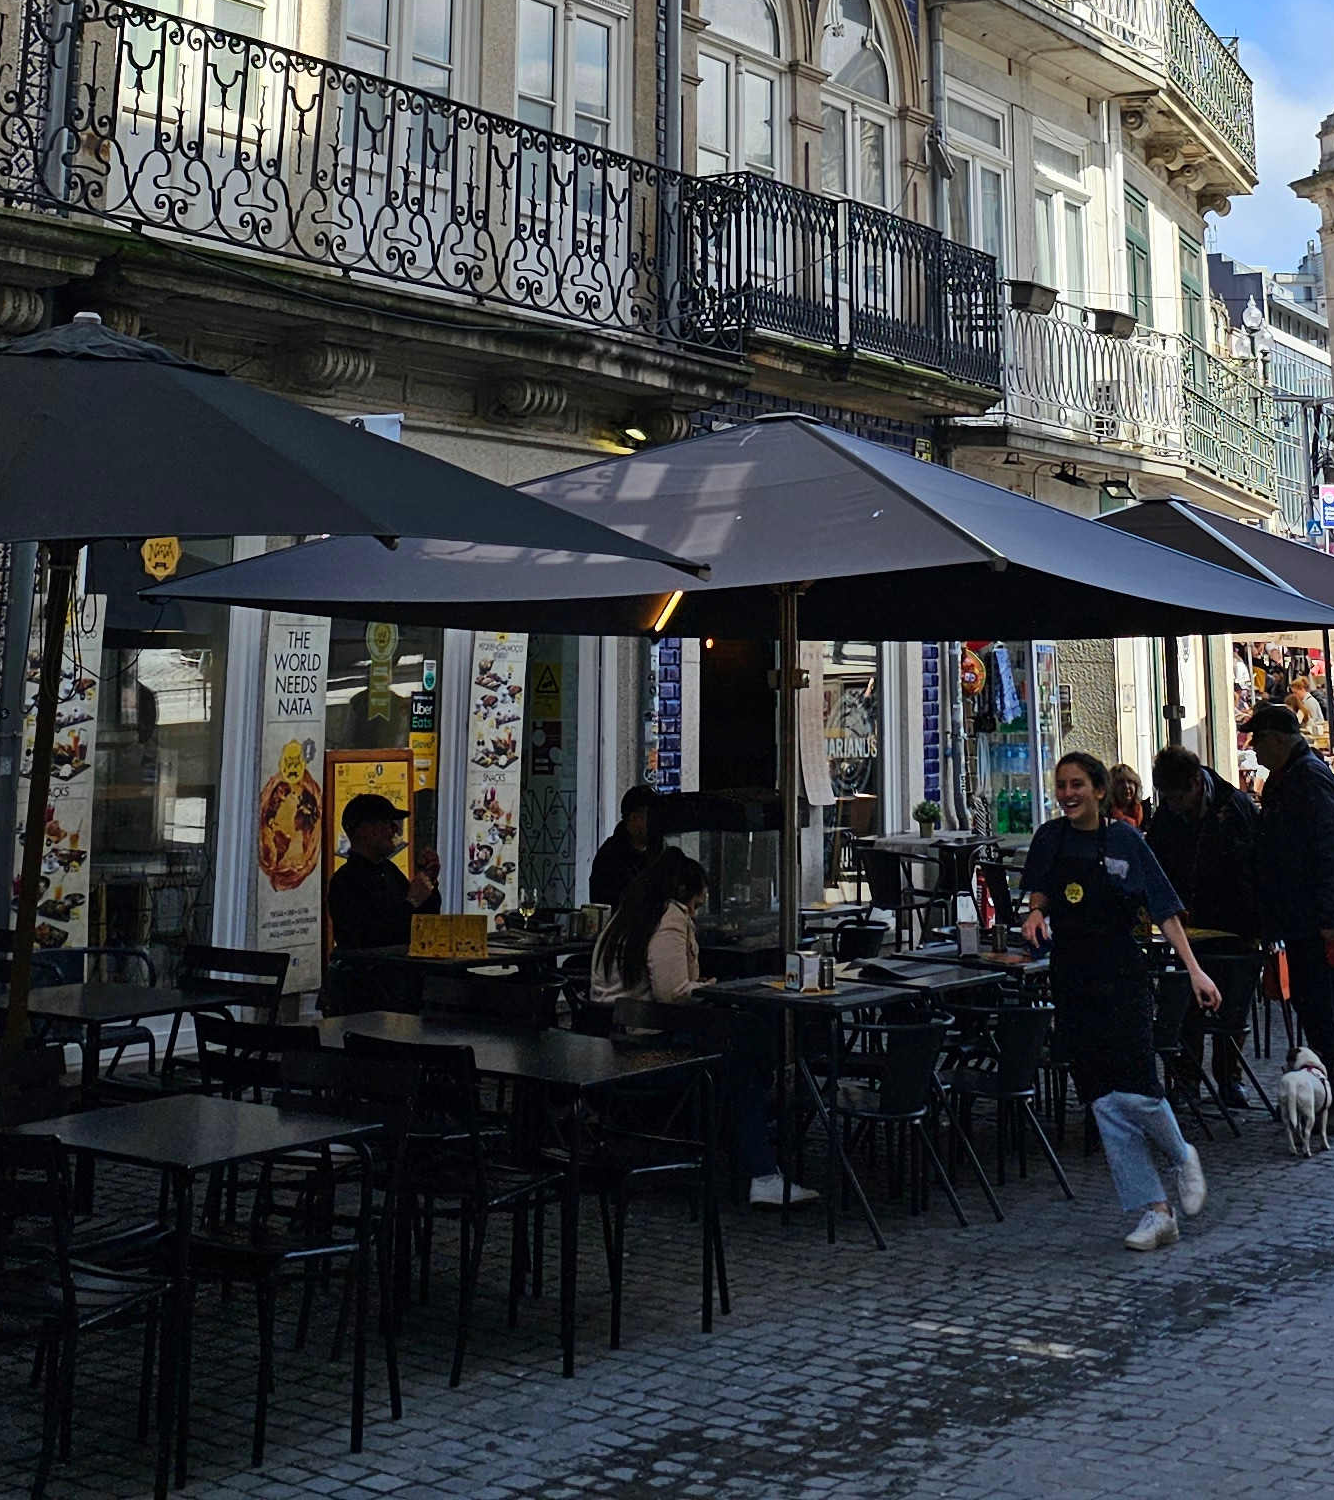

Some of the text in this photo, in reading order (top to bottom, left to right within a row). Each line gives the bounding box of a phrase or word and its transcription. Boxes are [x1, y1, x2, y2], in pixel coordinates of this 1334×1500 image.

[288, 631, 311, 649] THE
[274, 653, 322, 671] WORLD
[275, 675, 317, 694] NEEDS
[278, 697, 313, 715] NATA
[412, 701, 433, 715] Uber
[412, 716, 433, 729] Eats
